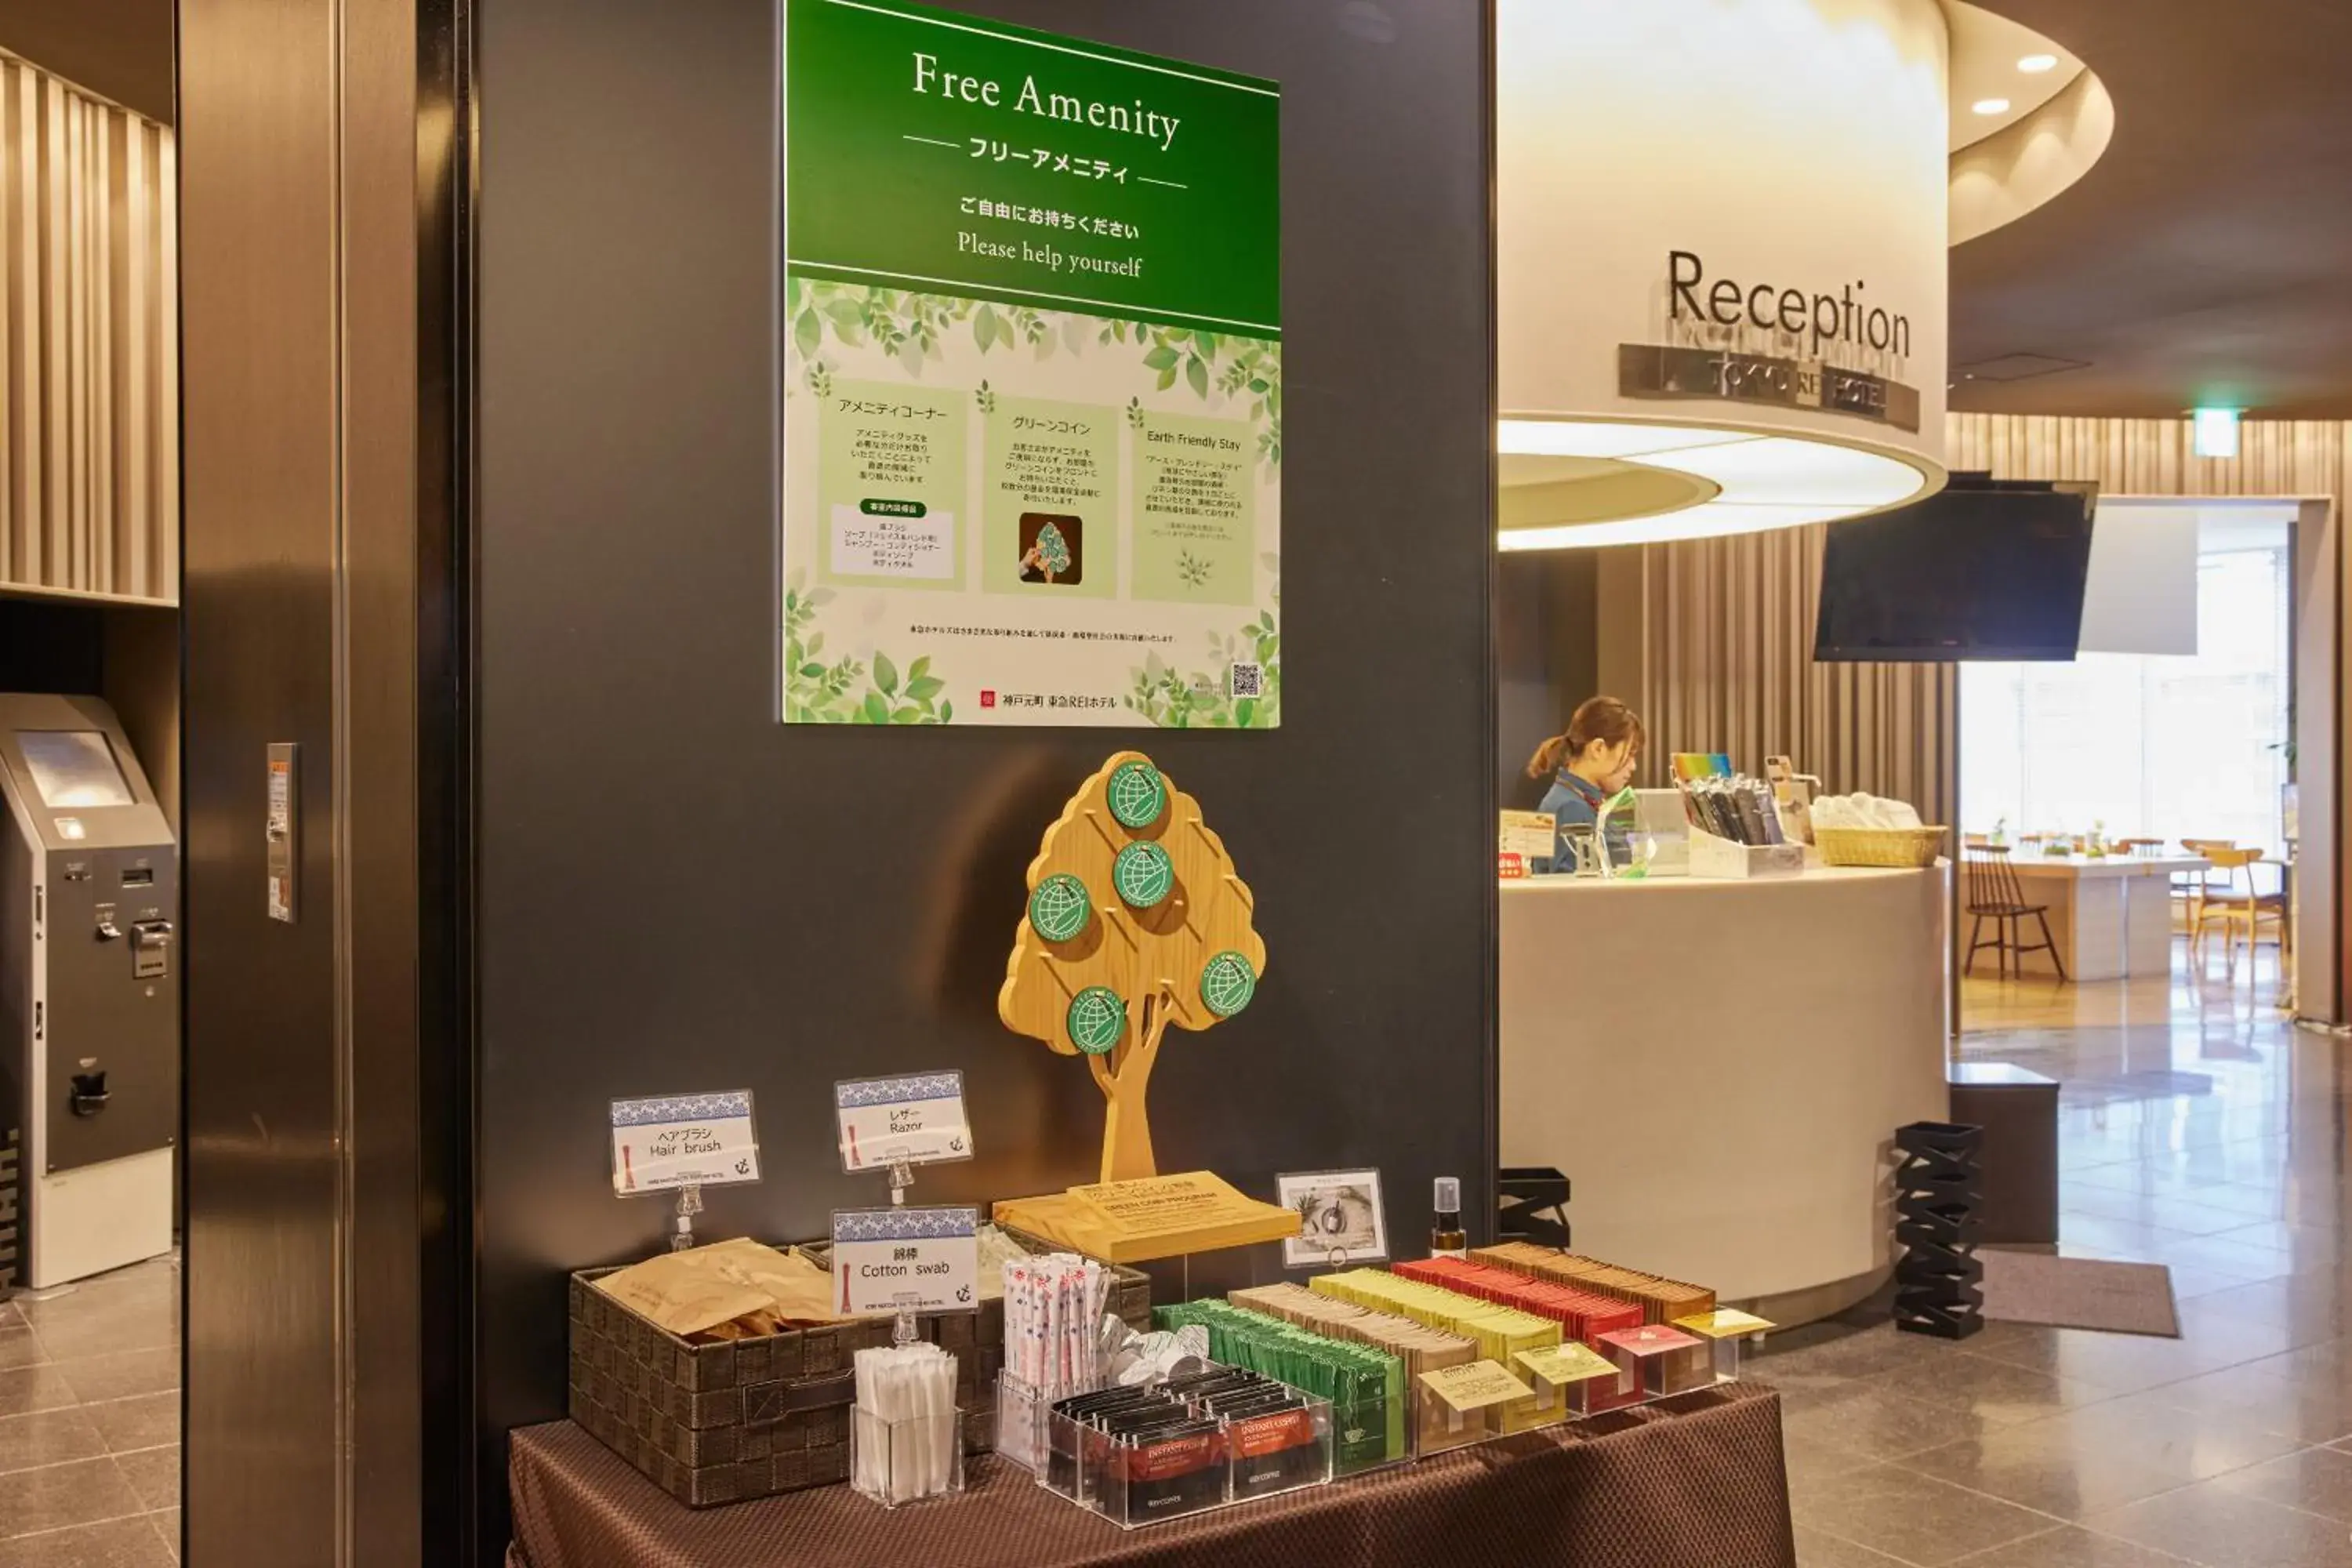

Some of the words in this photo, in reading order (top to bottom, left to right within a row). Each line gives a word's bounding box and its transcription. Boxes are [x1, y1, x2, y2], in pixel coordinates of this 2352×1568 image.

[911, 52, 1000, 106] Free
[1013, 75, 1181, 151] Amenity
[969, 137, 1128, 185] フリーアメニティ
[960, 197, 1139, 238] ご自由にお持ちください
[958, 231, 1017, 260] Please
[1022, 242, 1063, 270] help
[1069, 255, 1143, 278] yourself
[1668, 250, 1911, 358] Reception
[840, 399, 947, 419] アメニティコーナー
[1013, 416, 1091, 434] グリーンコイン
[1147, 431, 1174, 443] Earth
[1178, 433, 1216, 449] Friendly
[1219, 438, 1242, 452] Stay
[889, 1108, 921, 1120] レザー
[657, 1127, 712, 1142] ヘアブラシ
[889, 1120, 923, 1134] Razor
[649, 1142, 677, 1156] Hair
[684, 1138, 721, 1154] brush
[861, 1263, 907, 1278] Cotton
[915, 1261, 949, 1276] swab
